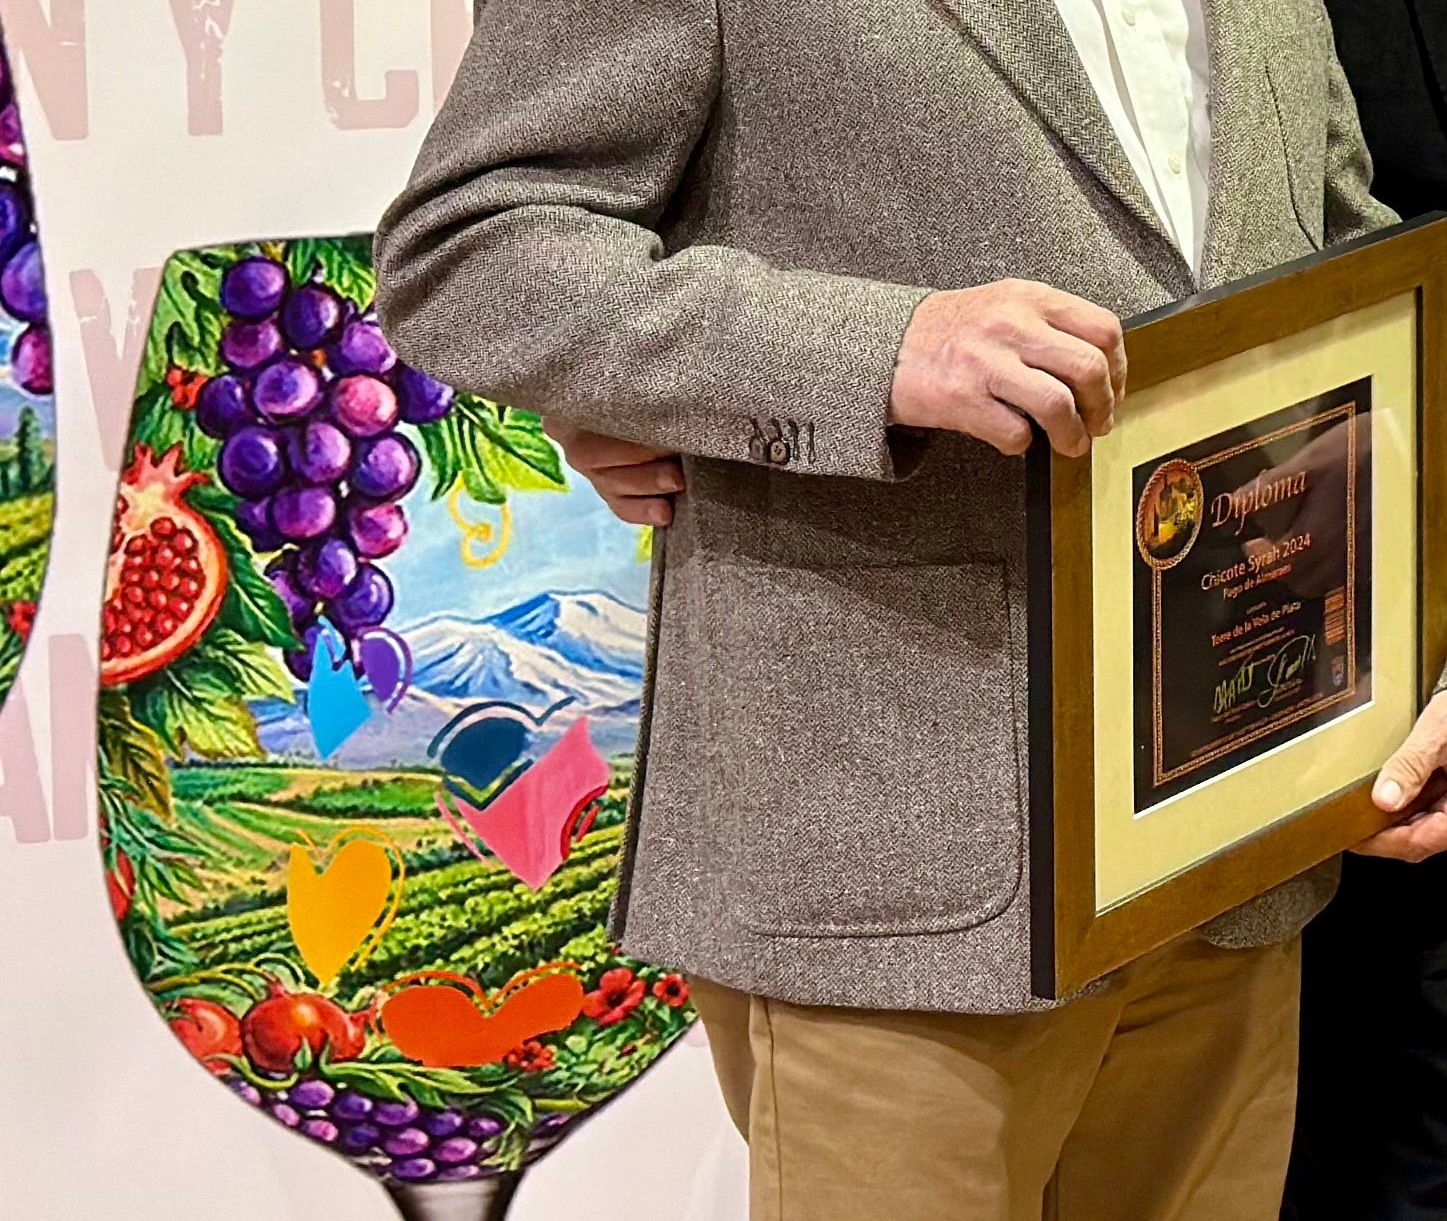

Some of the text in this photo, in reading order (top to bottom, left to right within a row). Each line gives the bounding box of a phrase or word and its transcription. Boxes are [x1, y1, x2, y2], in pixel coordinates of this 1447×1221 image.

[1210, 469, 1309, 537] Diploma
[1248, 544, 1280, 573] Syrah
[1283, 532, 1312, 557] 2024
